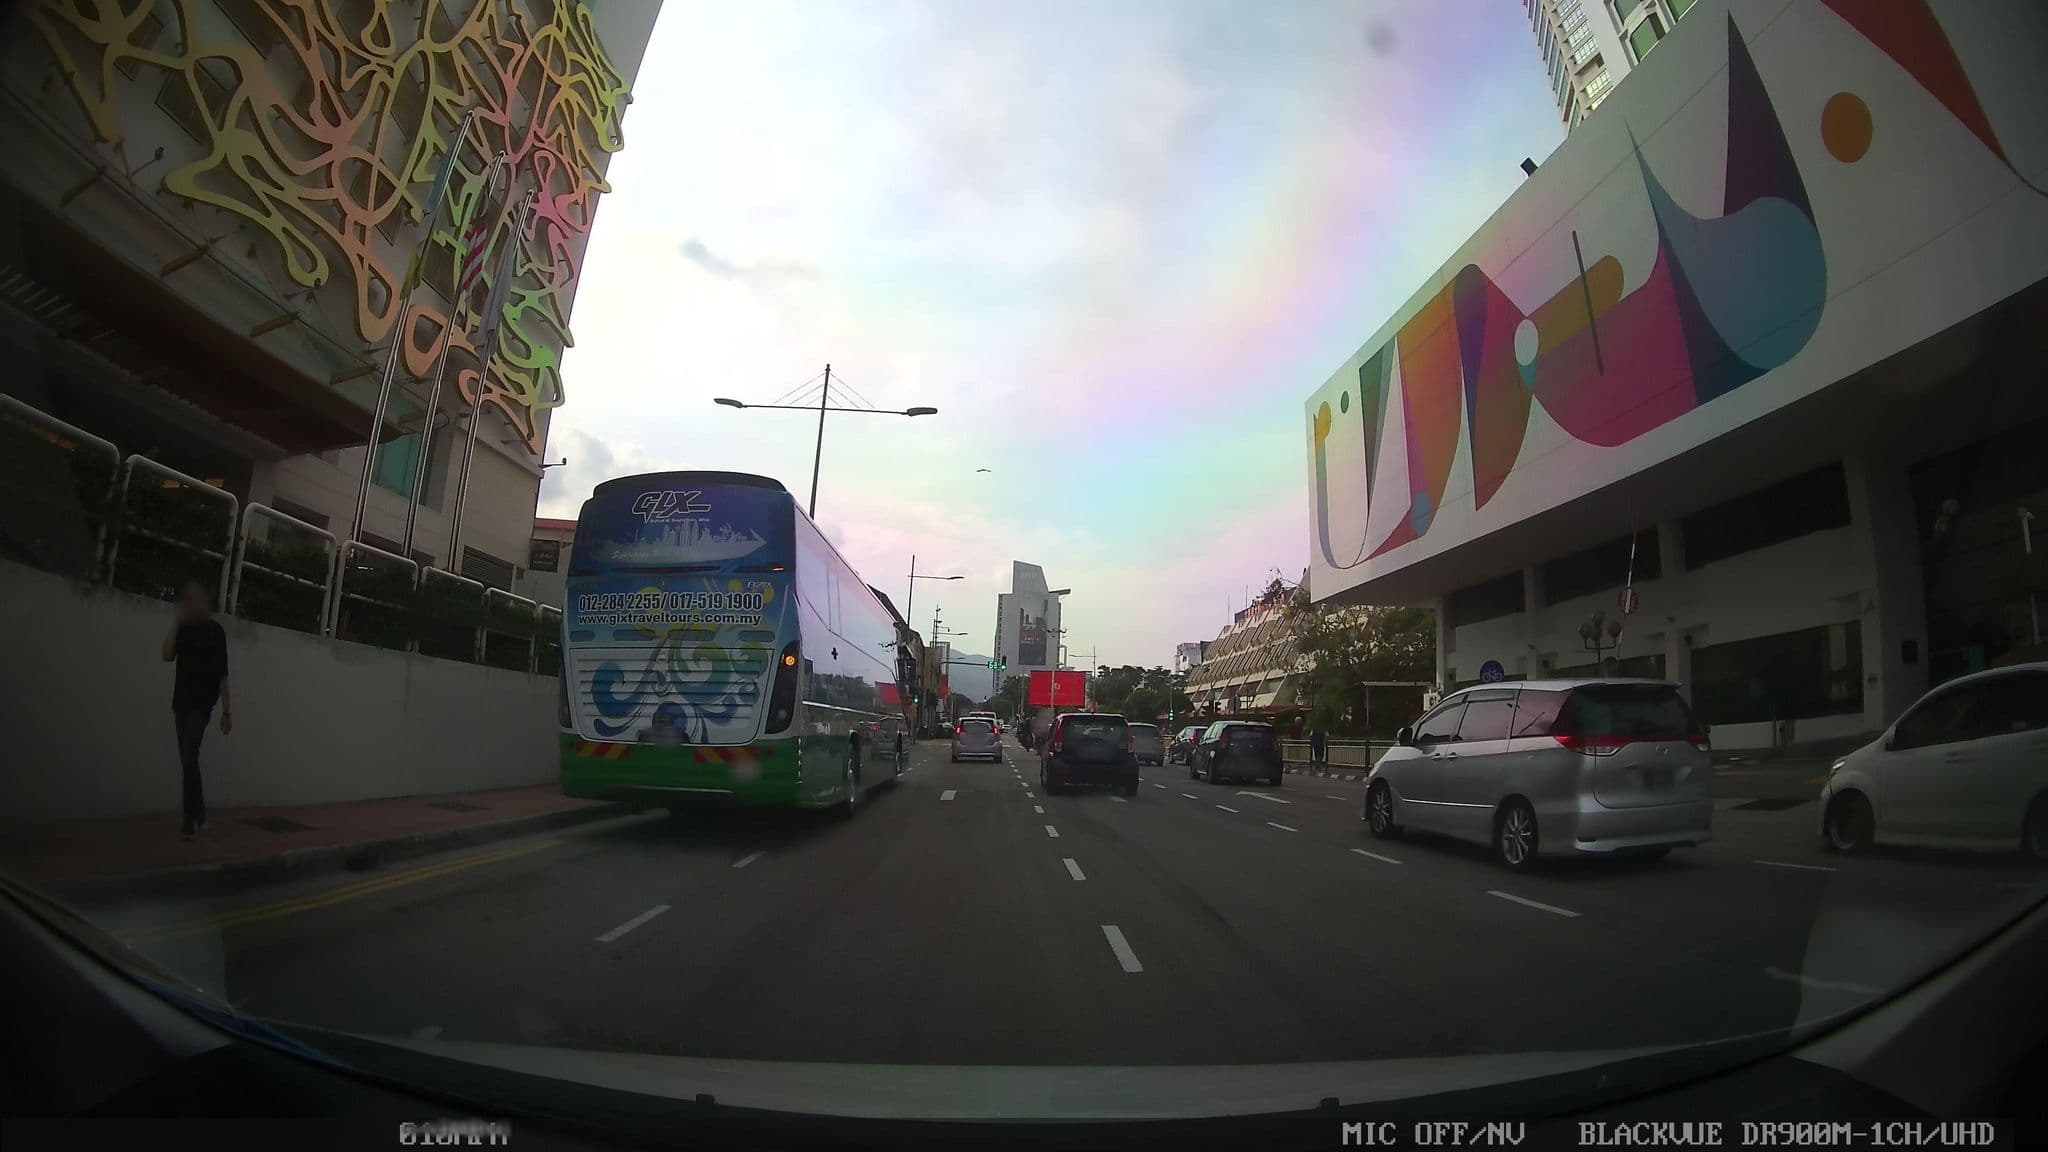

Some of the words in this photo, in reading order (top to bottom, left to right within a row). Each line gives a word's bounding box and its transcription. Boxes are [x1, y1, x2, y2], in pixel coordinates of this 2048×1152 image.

[632, 491, 711, 523] GLX
[579, 592, 625, 612] 012-284
[669, 592, 723, 610] 017-519
[725, 592, 763, 611] 1900
[578, 611, 761, 627] www.glxtraveltours.com.my
